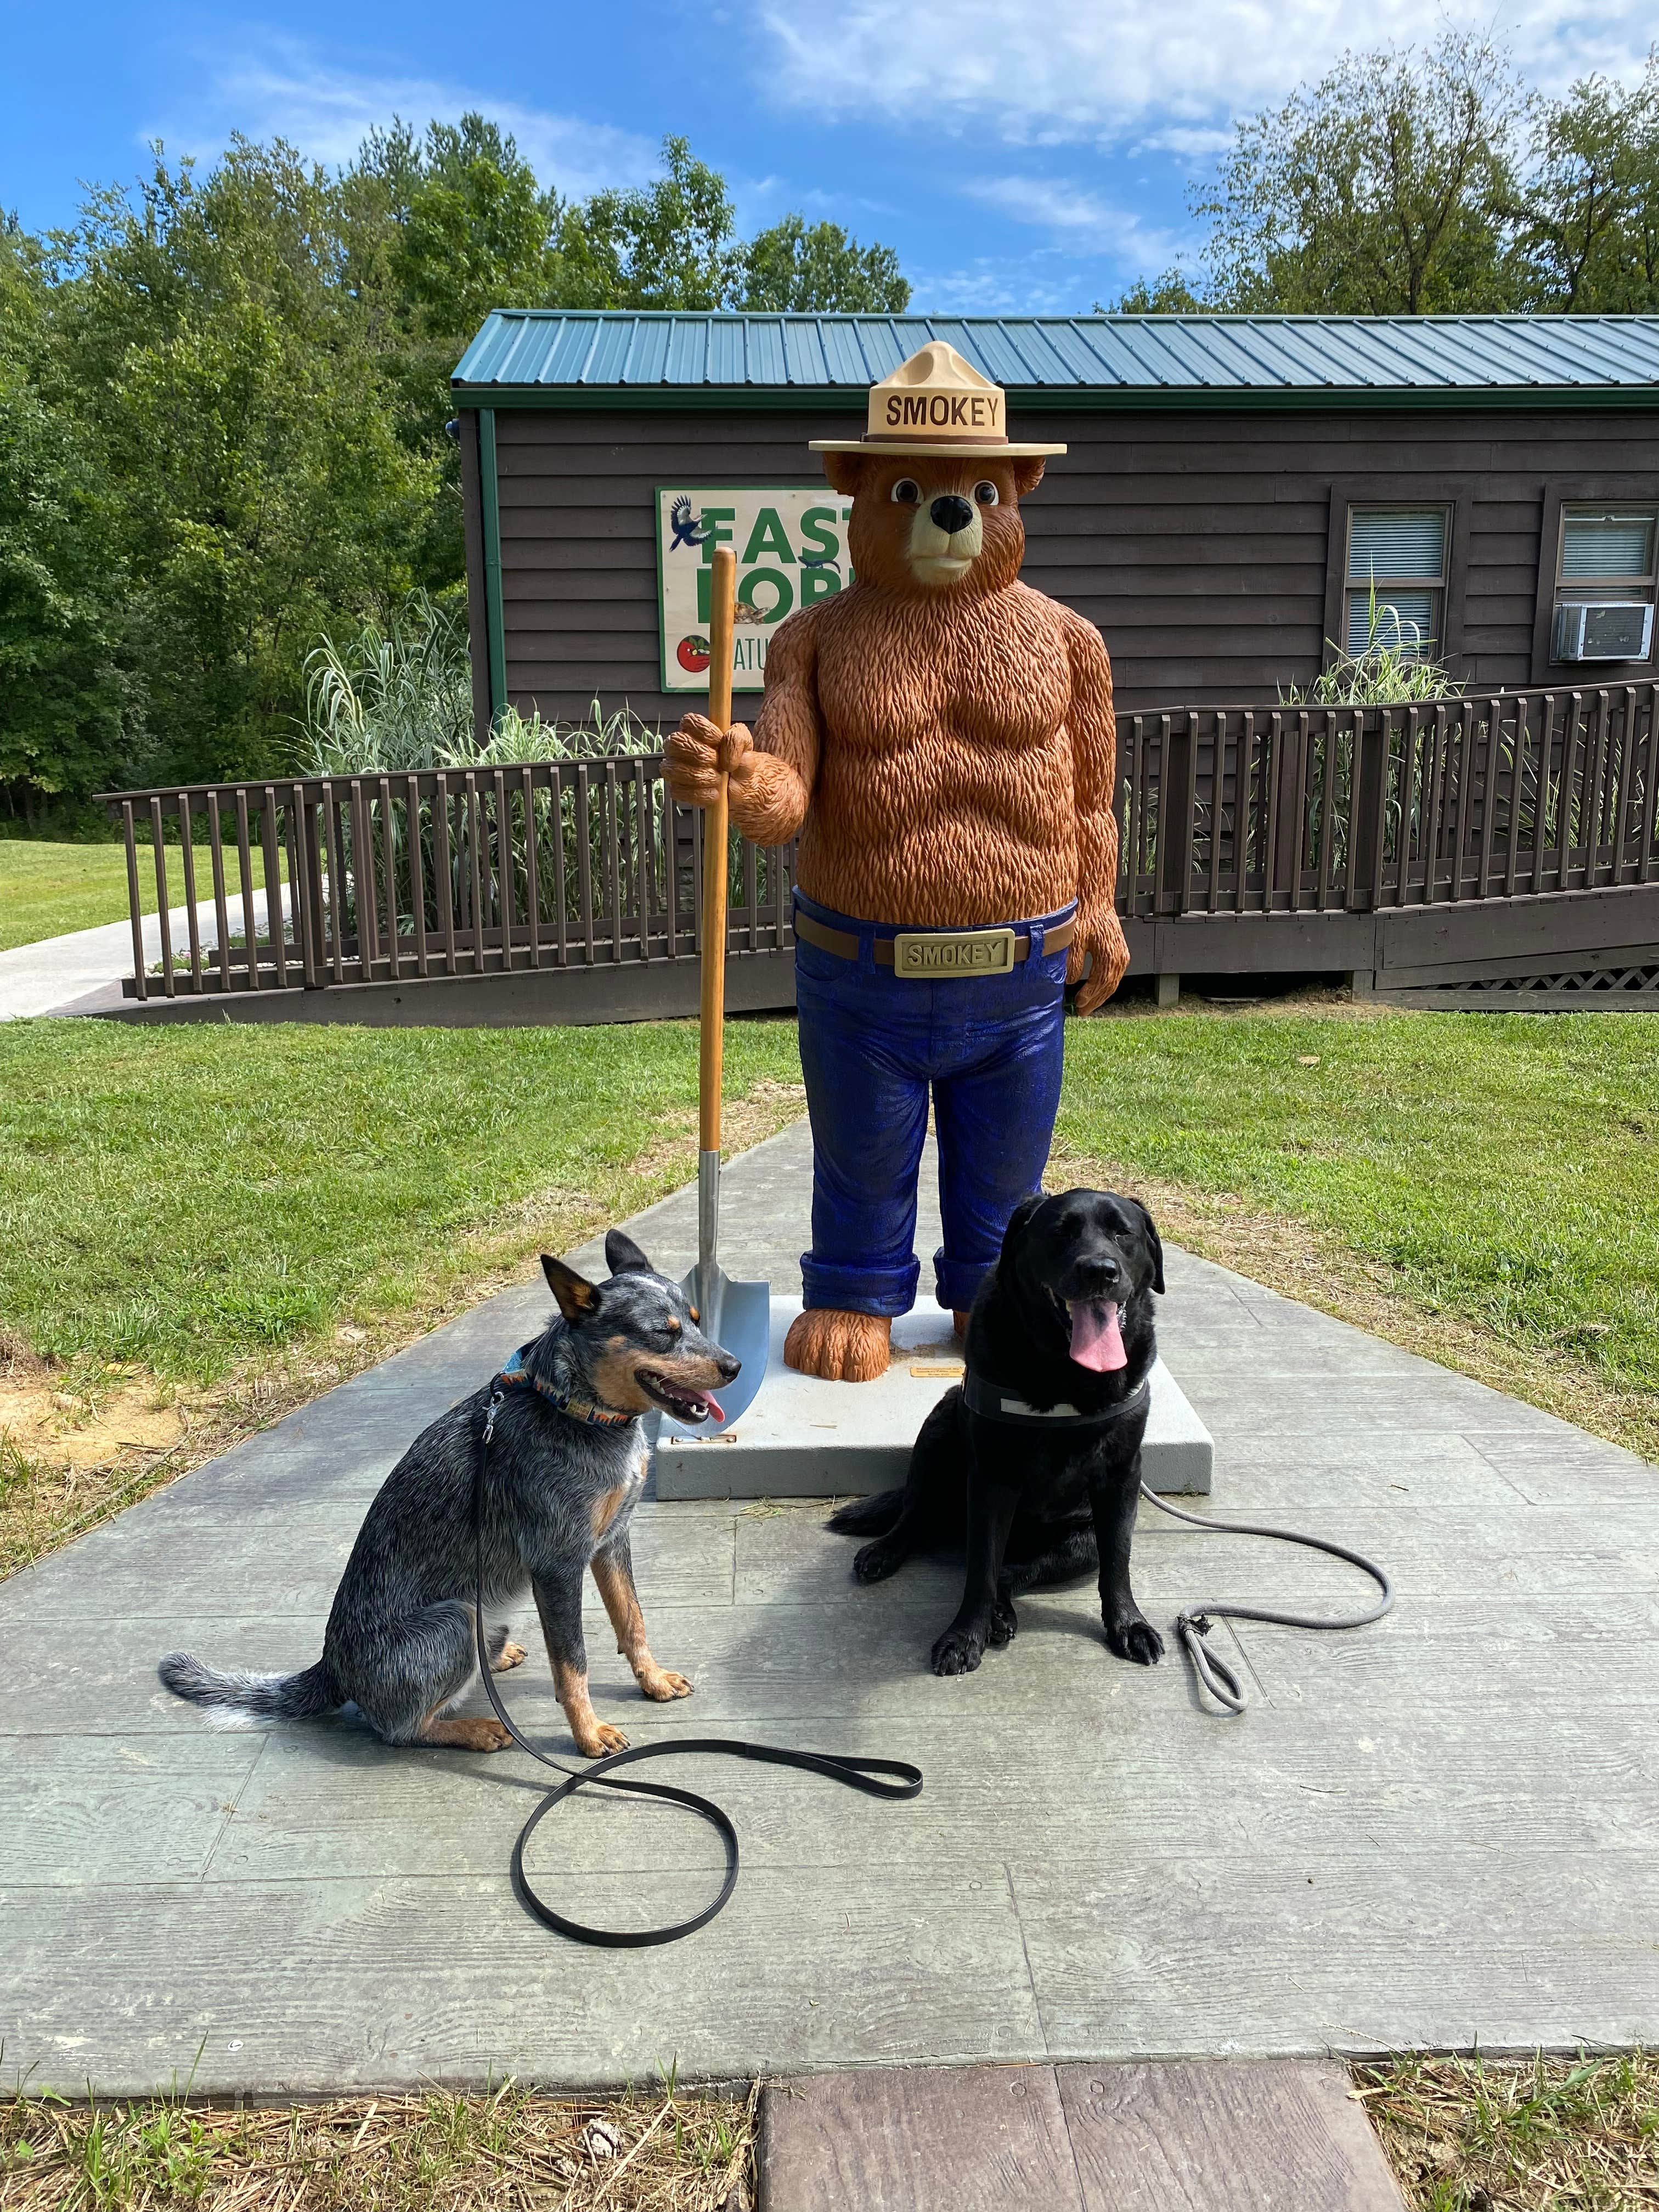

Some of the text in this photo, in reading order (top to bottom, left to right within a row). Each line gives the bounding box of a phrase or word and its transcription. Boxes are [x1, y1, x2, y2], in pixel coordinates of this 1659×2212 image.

[886, 394, 998, 426] SMOKEY
[733, 638, 769, 670] ATU
[907, 941, 1002, 967] SMOKEY
